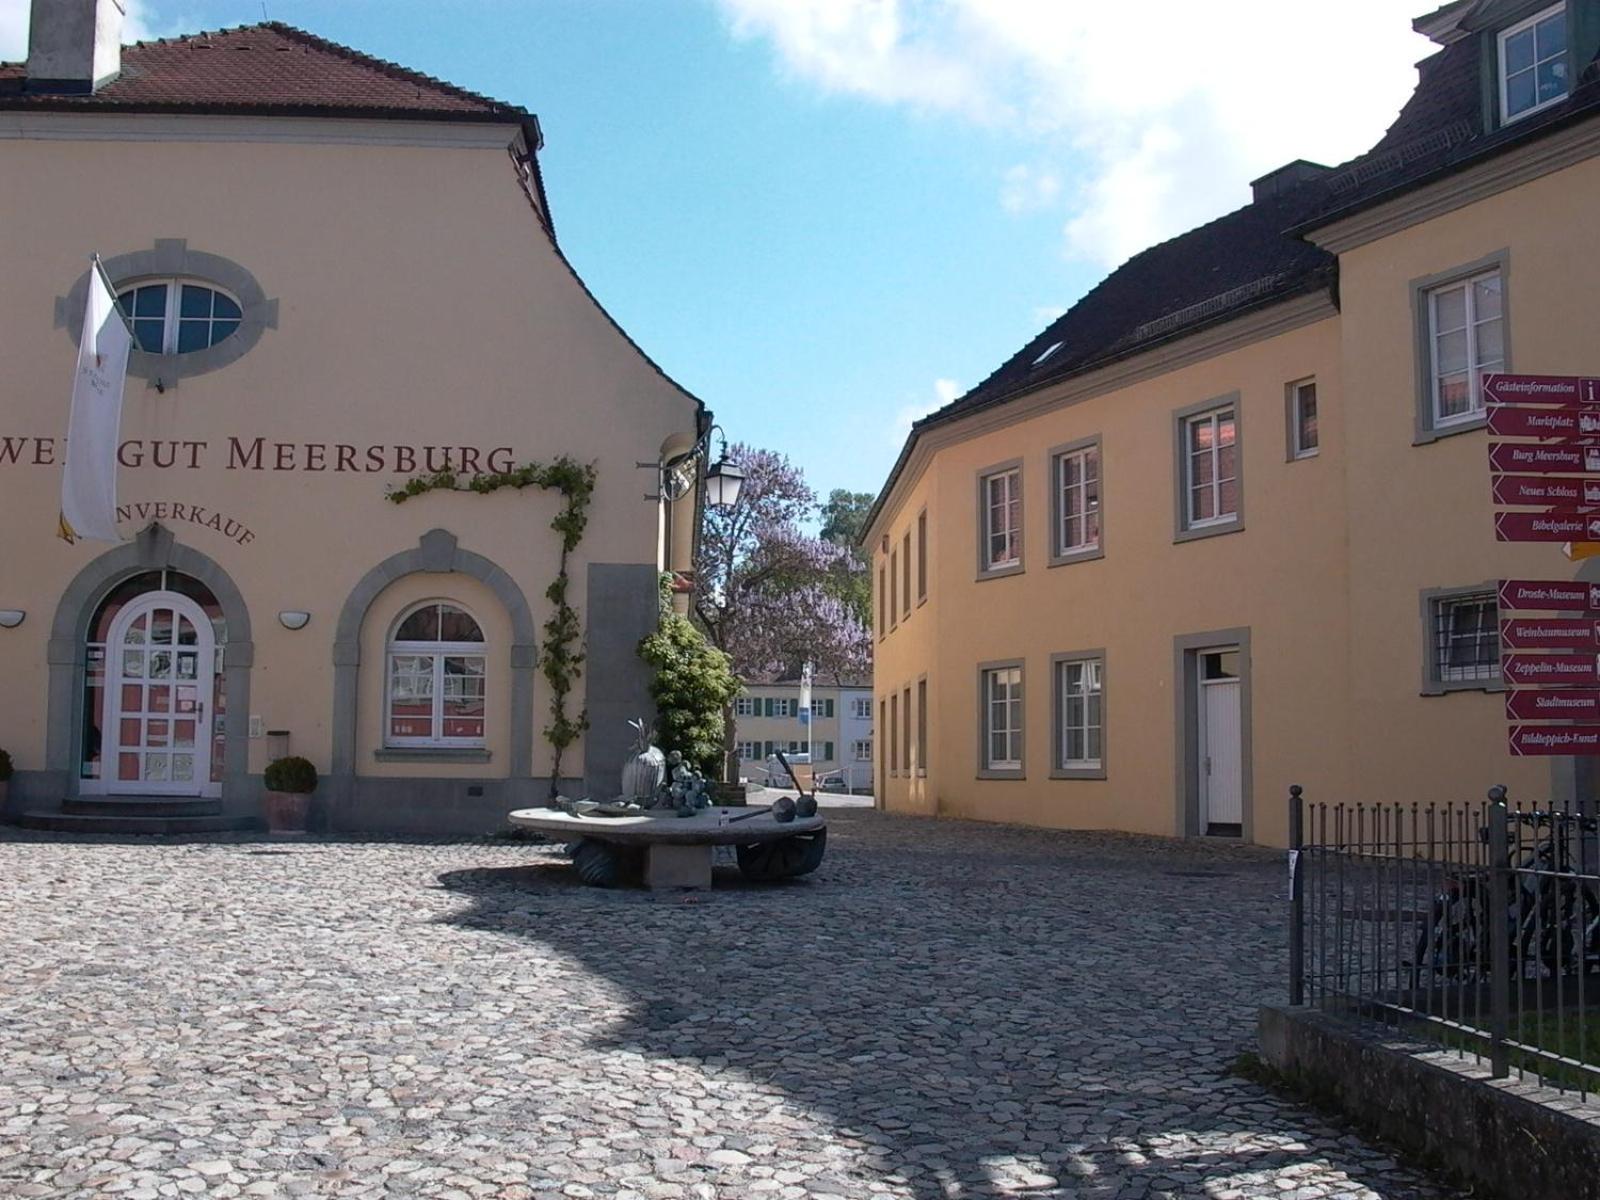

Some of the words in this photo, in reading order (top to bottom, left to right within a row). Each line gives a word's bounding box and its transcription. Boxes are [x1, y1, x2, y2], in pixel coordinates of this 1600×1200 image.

[1495, 381, 1575, 395] Gästeinformation
[1526, 416, 1575, 430] Marktplatz
[0, 437, 208, 468] WEGUT
[226, 436, 516, 475] MEERSBURG
[1512, 449, 1534, 463] Burg
[1535, 450, 1580, 464] Meersburg
[1519, 485, 1545, 496] Neues
[1547, 485, 1578, 497] Schloss
[65, 501, 256, 546] NVERKAUF
[1532, 519, 1584, 534] Bibelgalerie
[1517, 588, 1585, 600] Droste-Museum
[1516, 626, 1591, 638] Weinbaumuseum
[1514, 661, 1593, 676] Zeppelin-Museum
[1536, 695, 1595, 708] Stadtmuseum
[1521, 732, 1598, 747] Bildteppich-Kunst
